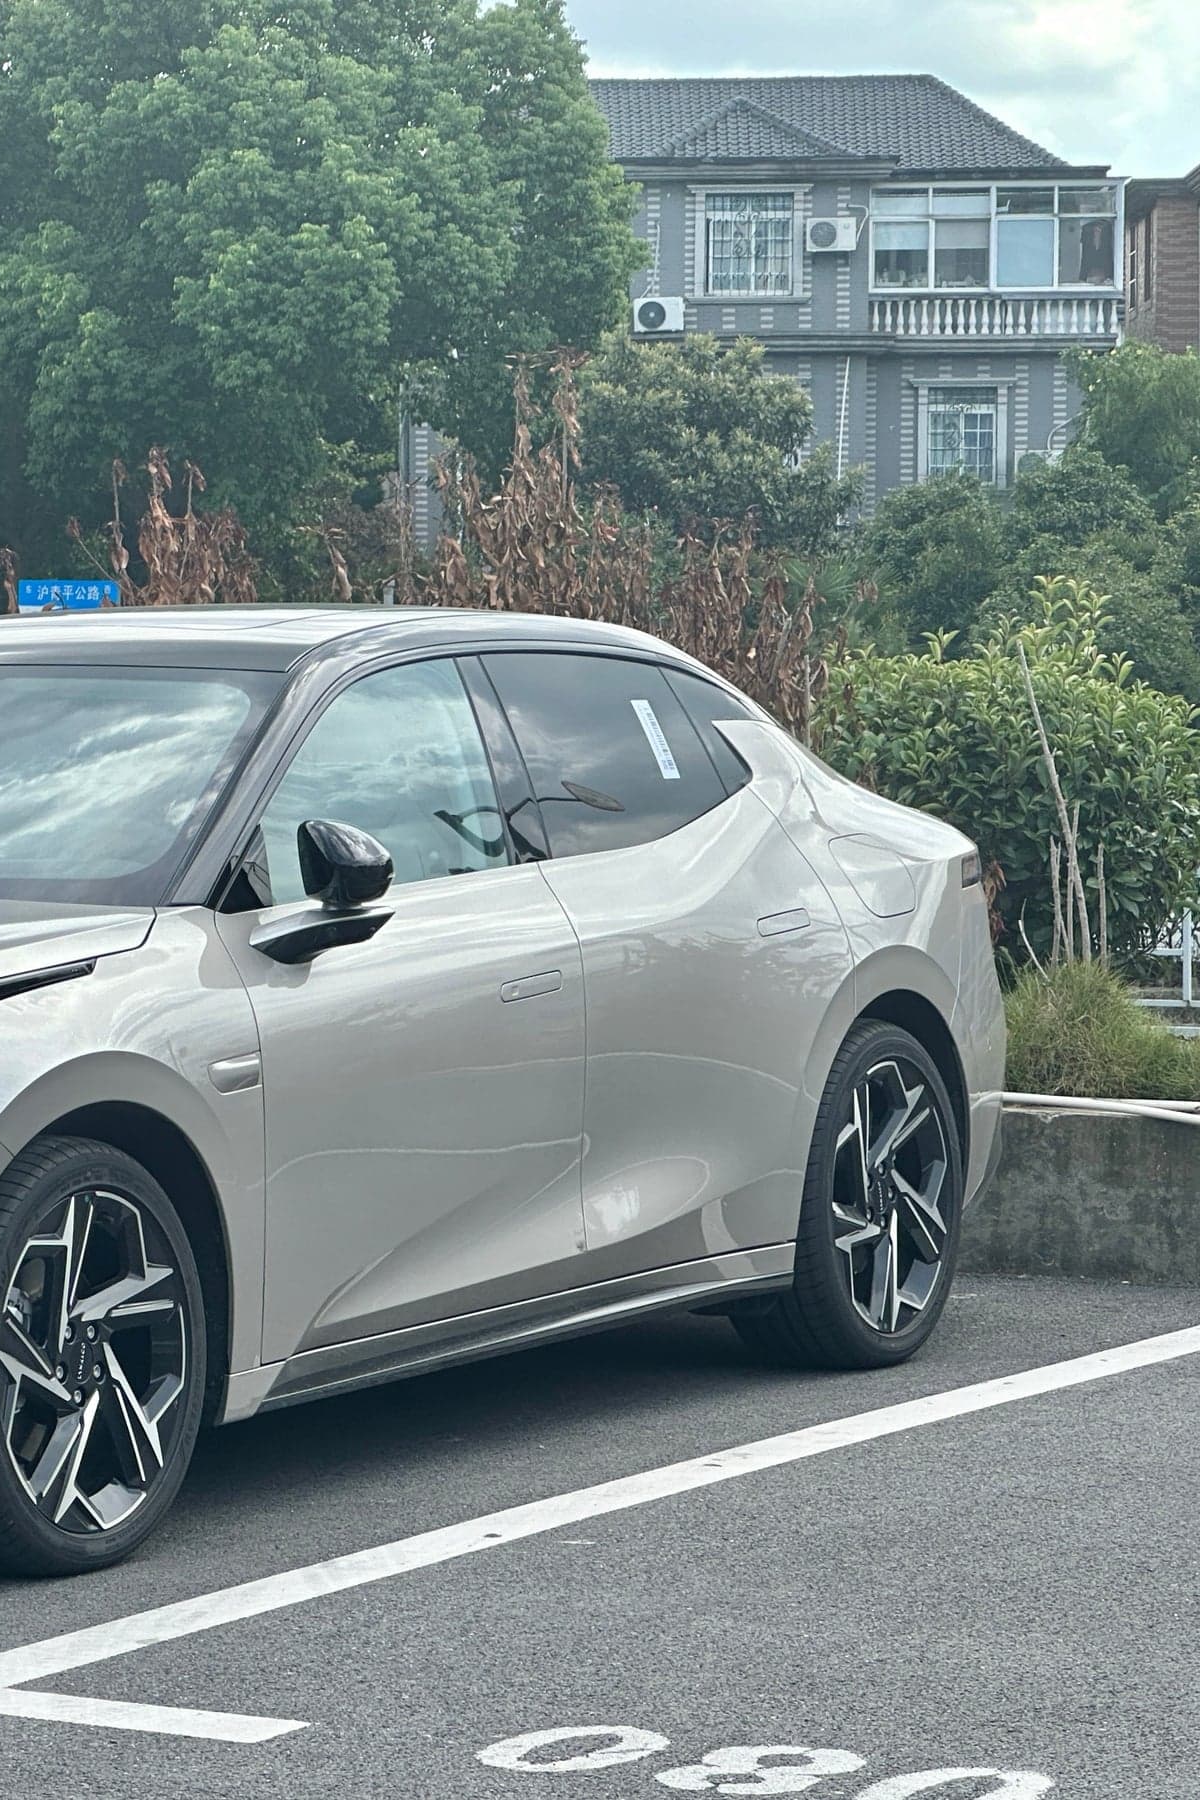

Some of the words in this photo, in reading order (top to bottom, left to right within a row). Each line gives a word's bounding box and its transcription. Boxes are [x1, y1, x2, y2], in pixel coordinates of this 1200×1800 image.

[37, 584, 99, 600] 沪青平公路
[476, 1724, 1054, 1800] 080
